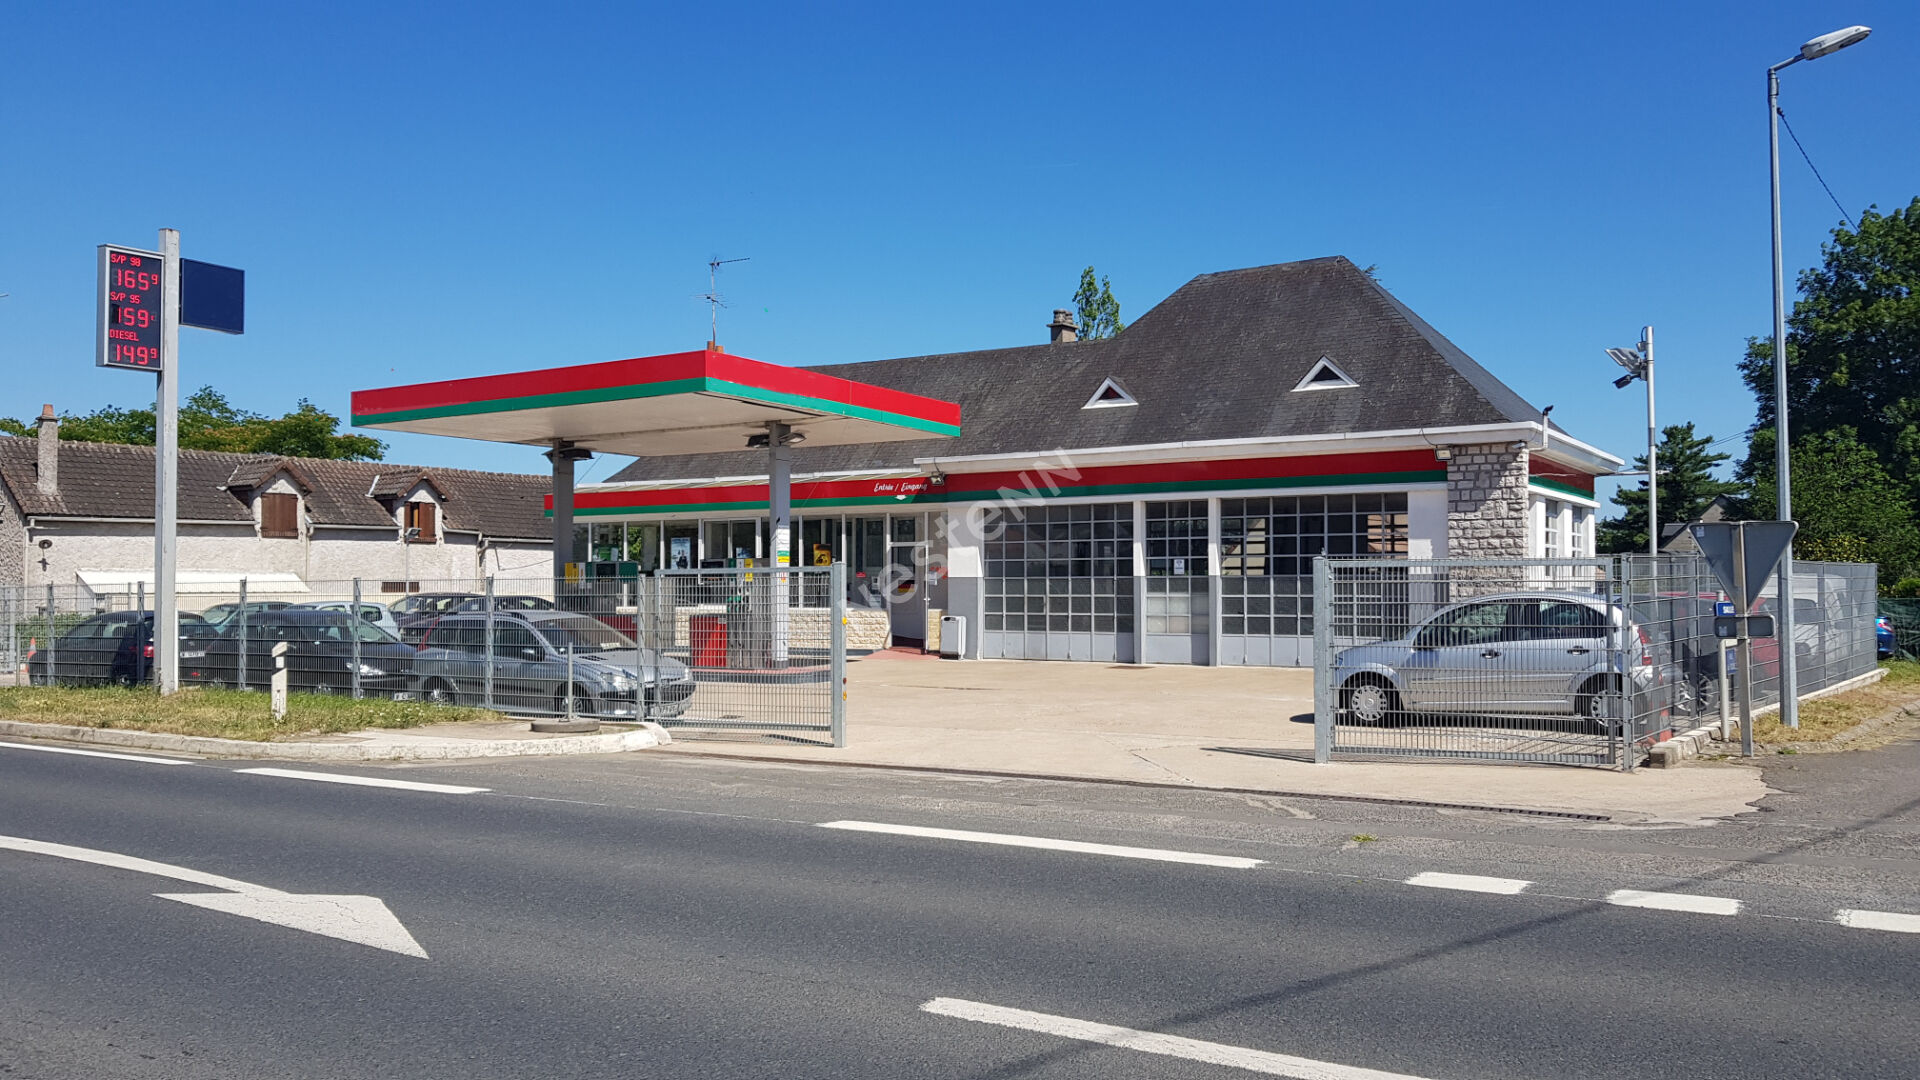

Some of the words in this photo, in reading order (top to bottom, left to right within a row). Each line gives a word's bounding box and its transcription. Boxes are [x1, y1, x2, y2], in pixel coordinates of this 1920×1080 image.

[110, 253, 127, 264] S/P
[130, 256, 142, 267] 98
[110, 291, 126, 302] S/P
[129, 294, 141, 304] 95
[109, 328, 140, 342] DIESEL
